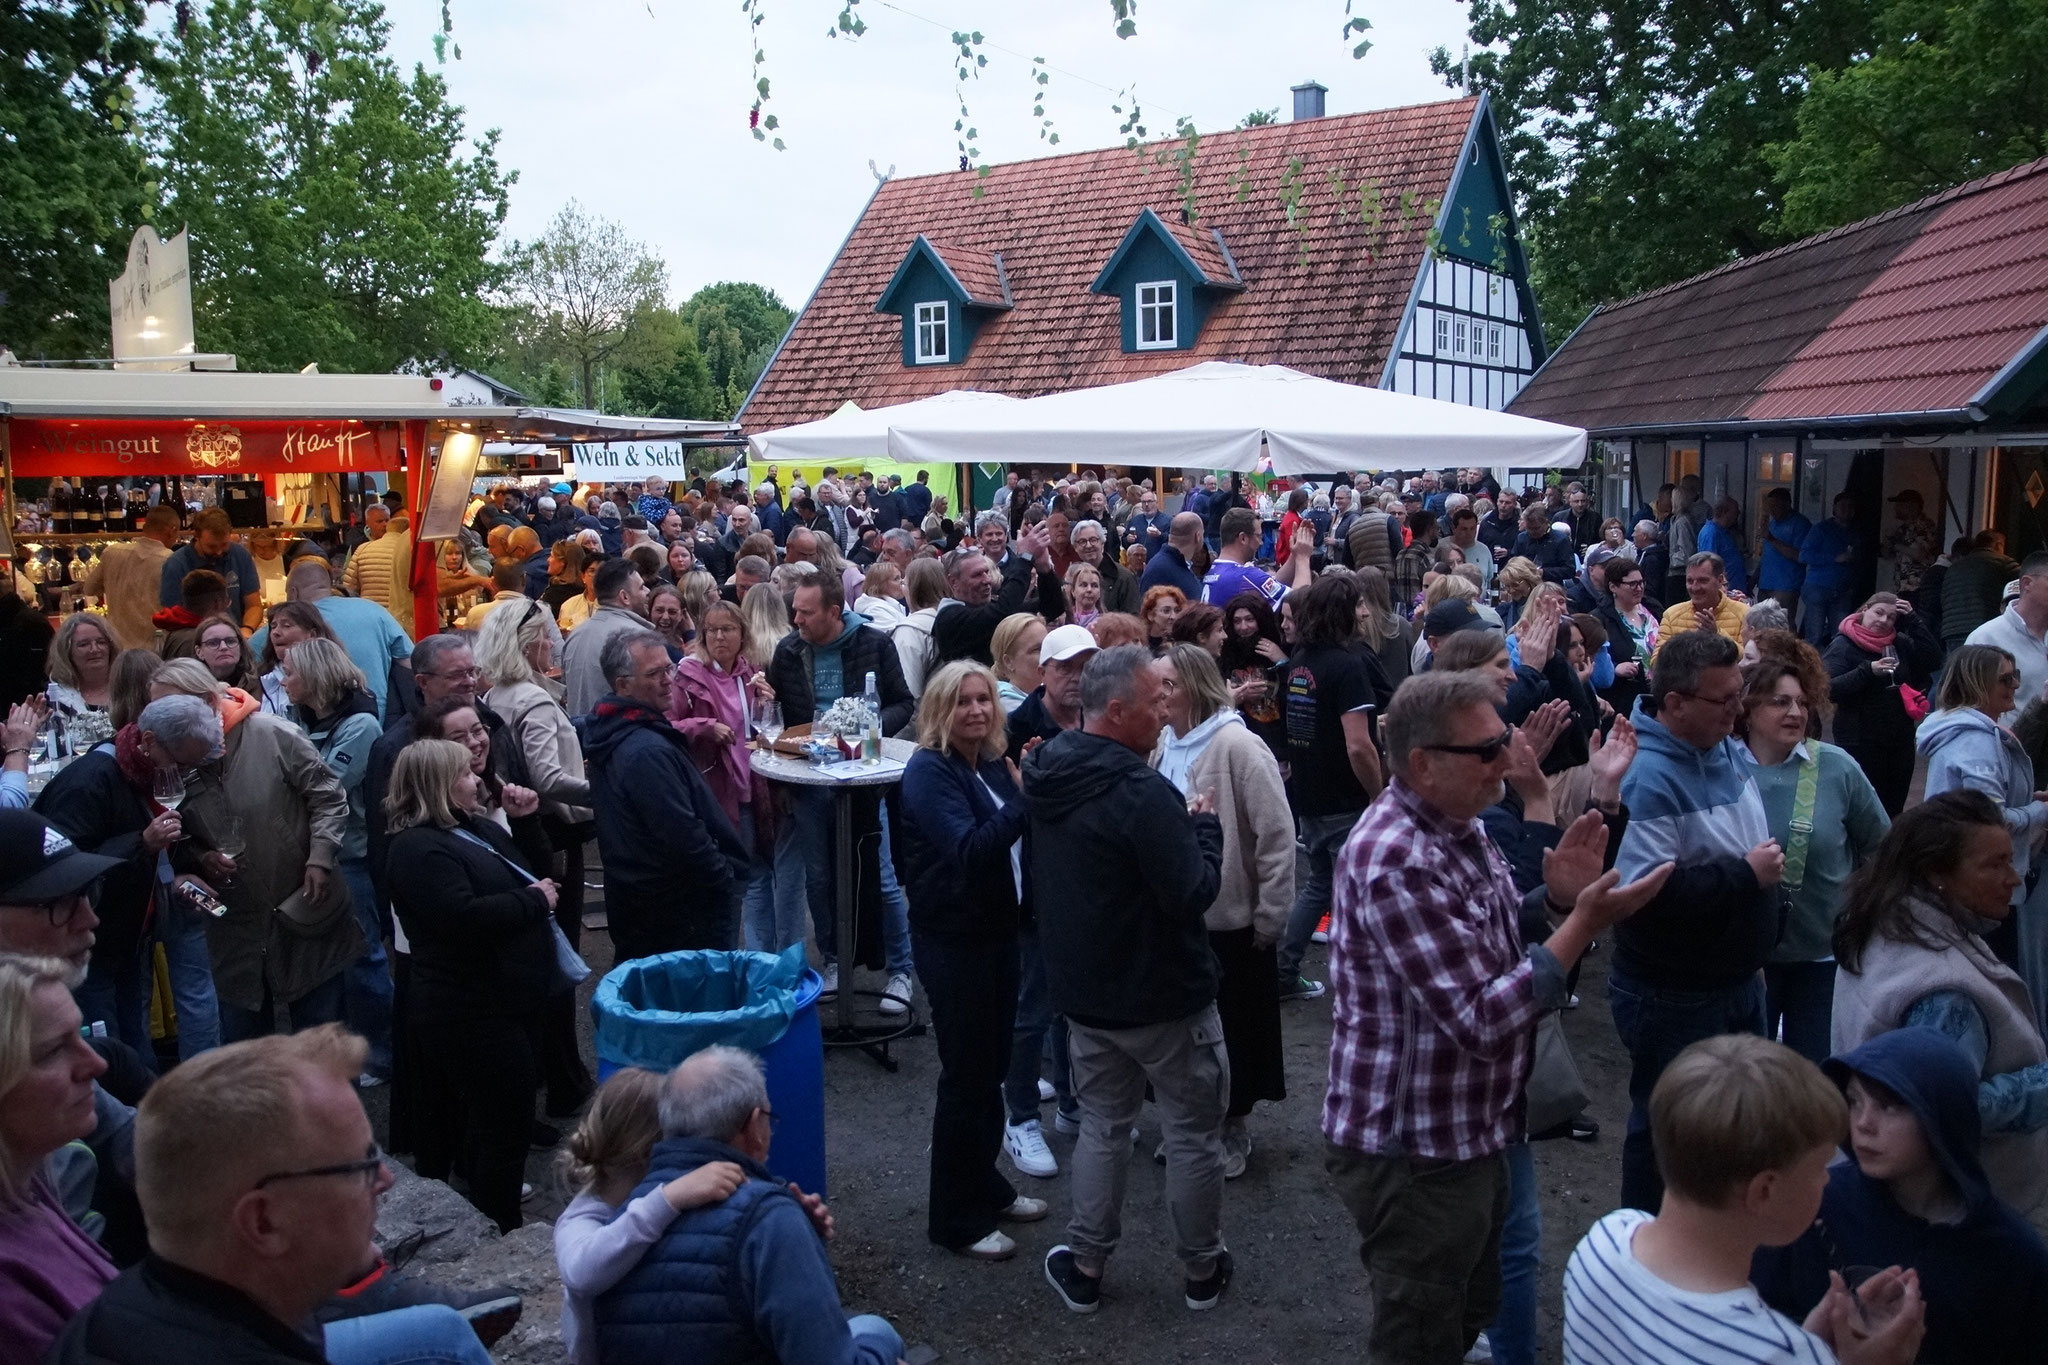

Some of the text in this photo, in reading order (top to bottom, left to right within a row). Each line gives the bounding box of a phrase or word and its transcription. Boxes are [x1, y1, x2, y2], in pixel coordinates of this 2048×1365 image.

[41, 430, 161, 463] Weingut
[575, 444, 681, 467] Wein & Sekt
